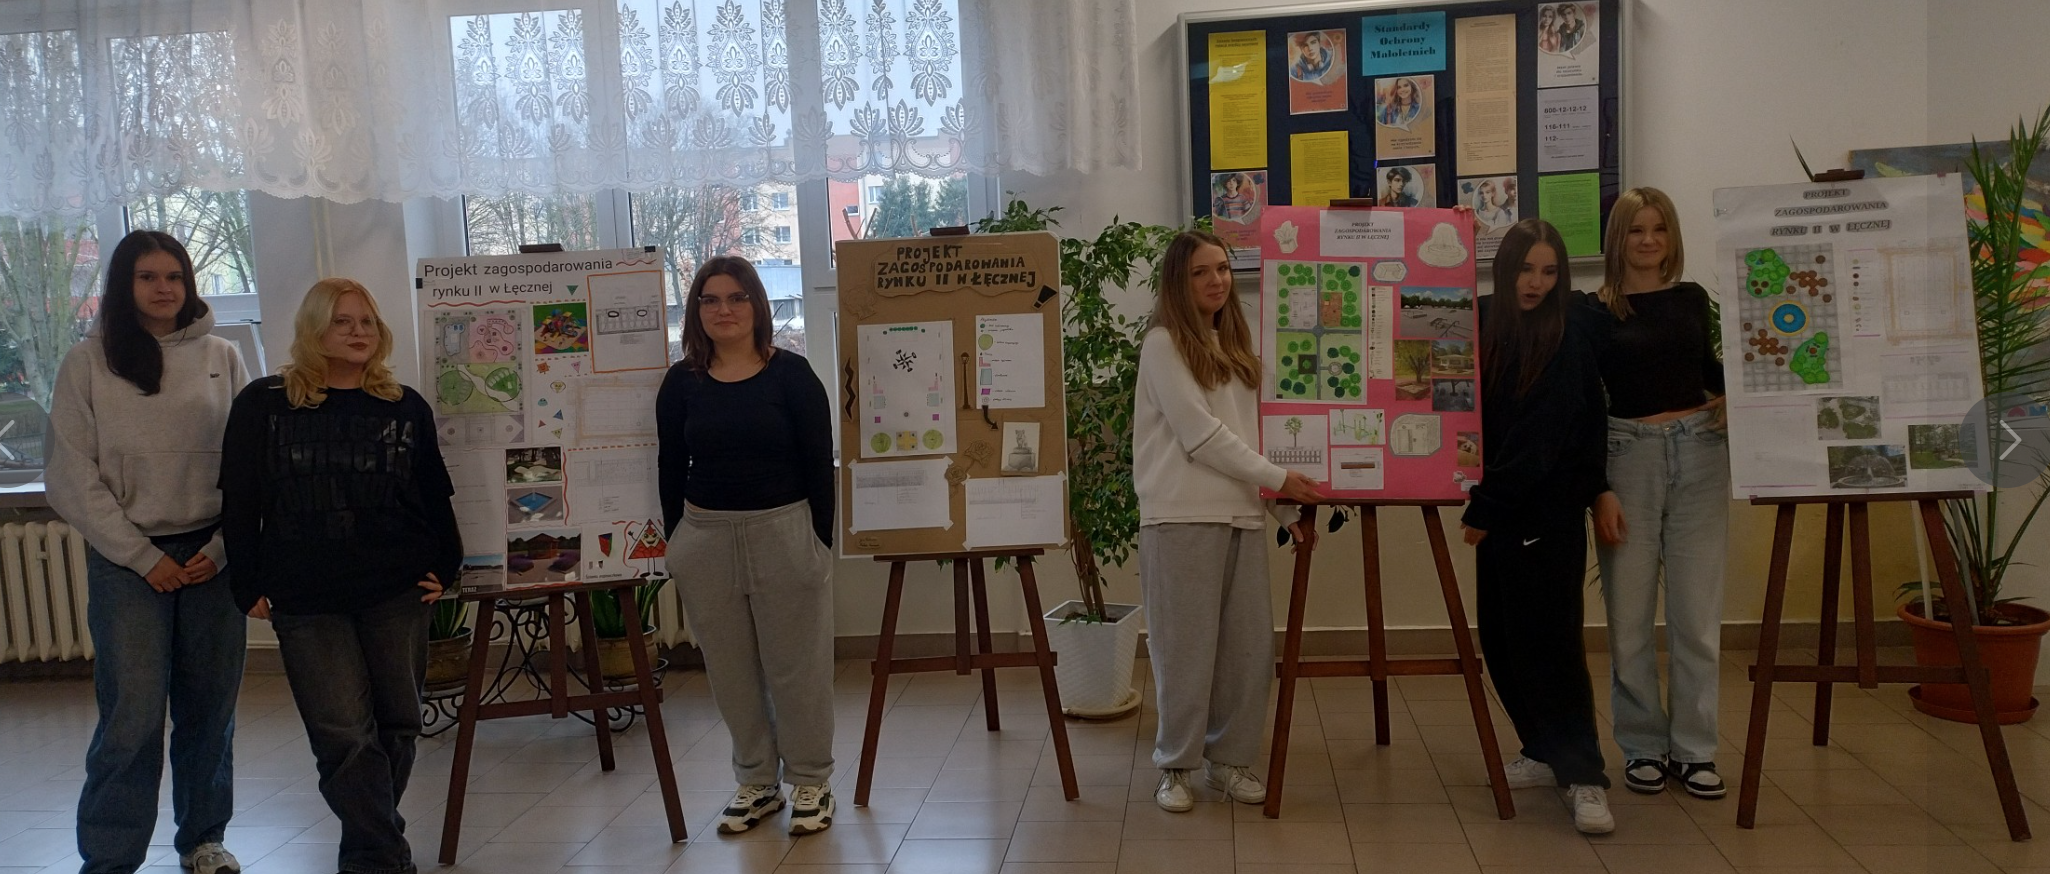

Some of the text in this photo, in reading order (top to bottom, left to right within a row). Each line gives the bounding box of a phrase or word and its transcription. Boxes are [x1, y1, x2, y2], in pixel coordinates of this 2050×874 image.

[1374, 21, 1431, 33] Standardy
[1379, 36, 1426, 46] Ochrony
[1544, 105, 1587, 113] 800-12-12-12
[1804, 189, 1847, 199] PROJEKT
[1774, 201, 1887, 217] ZAGOSPODAROWANIA
[1771, 226, 1808, 236] RYNKU
[1813, 225, 1822, 234] II
[1829, 224, 1841, 233] W
[896, 245, 963, 264] PROJEKT
[424, 258, 613, 280] Projekt zagospodarowania
[877, 256, 1026, 276] ZAGOSPODAROWANIA
[877, 271, 1036, 290] RYNKU II W ŁĘCZNEJ
[432, 281, 553, 300] rynku II w Łęcznej
